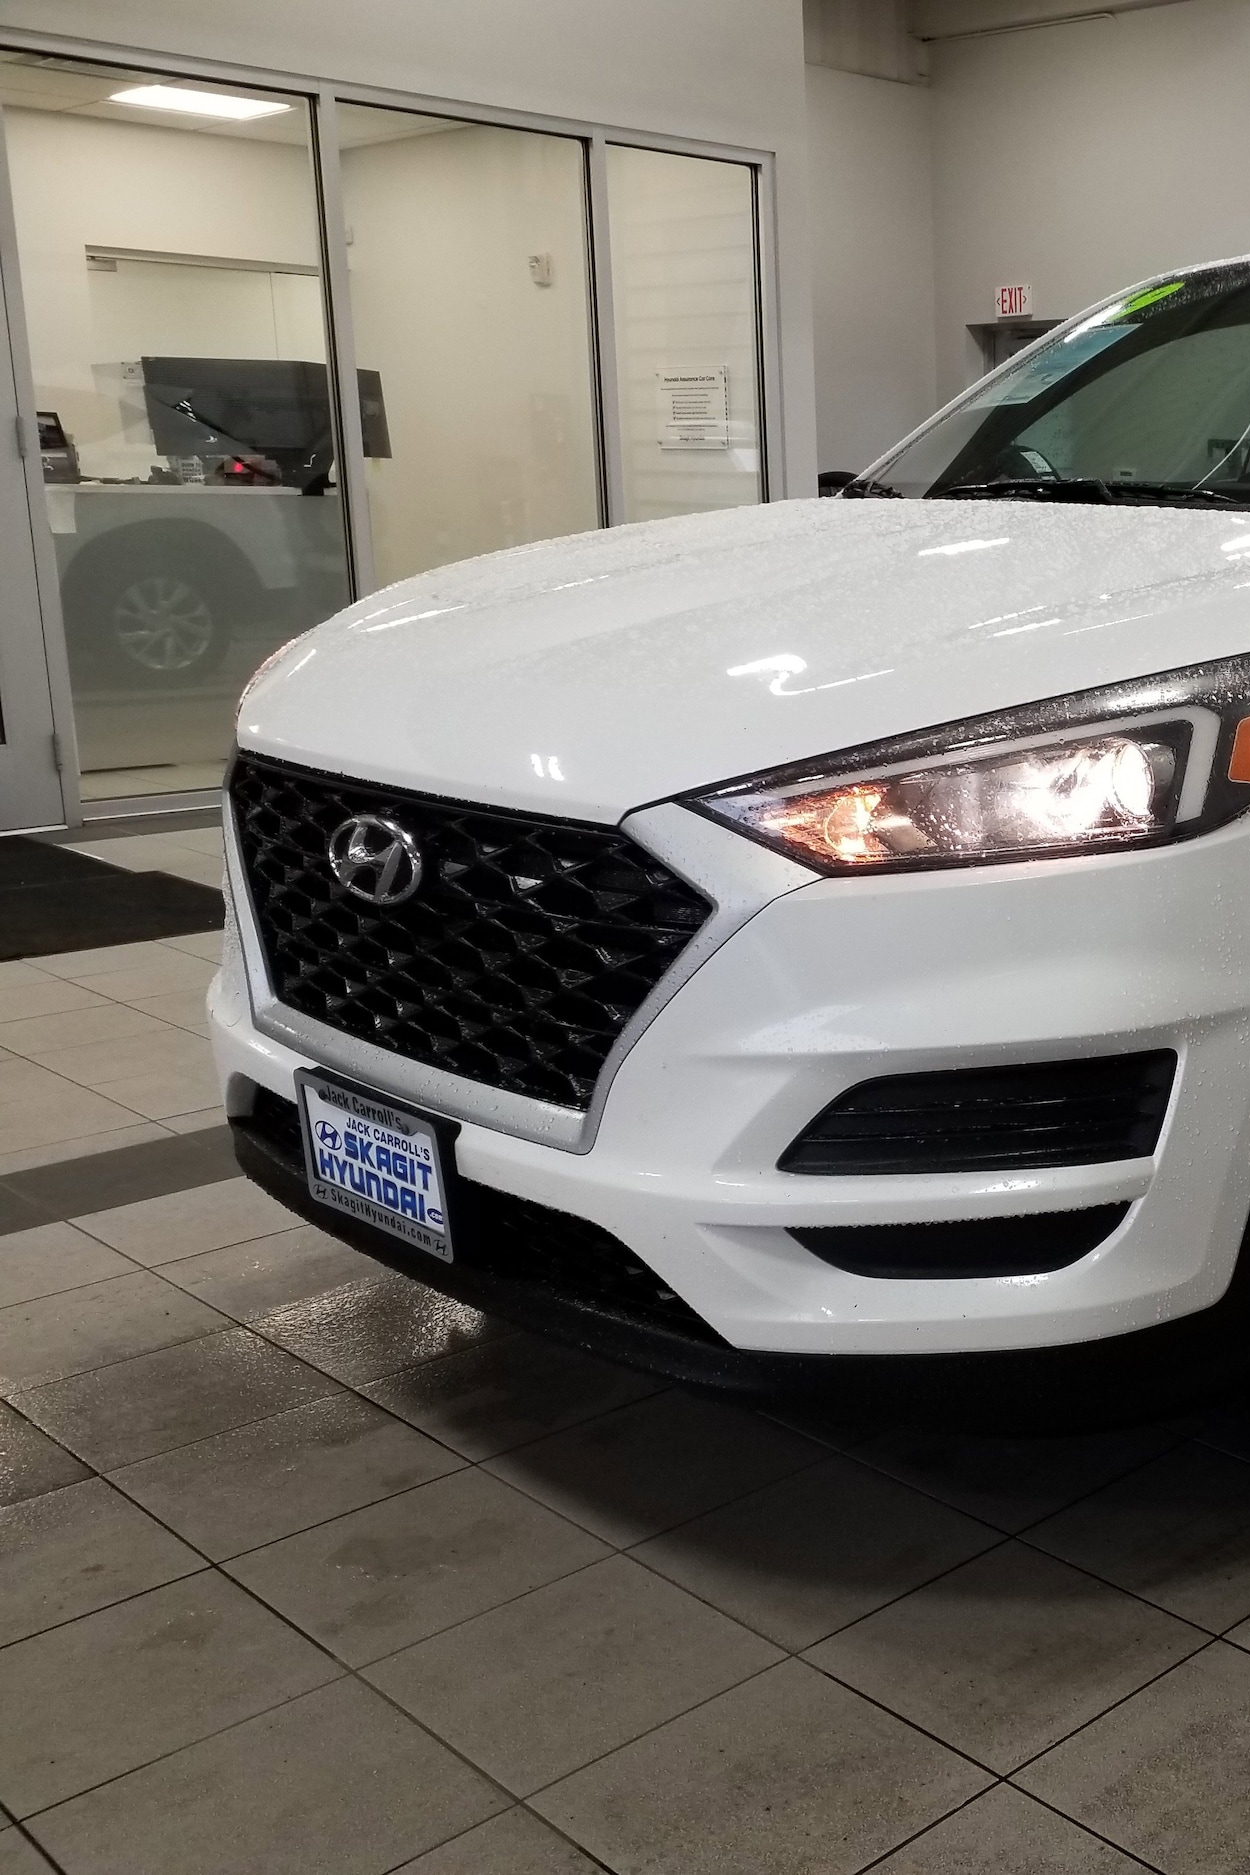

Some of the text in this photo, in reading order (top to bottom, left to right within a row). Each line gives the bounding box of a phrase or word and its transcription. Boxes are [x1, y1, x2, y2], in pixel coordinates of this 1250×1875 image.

[1001, 287, 1023, 314] EXIT
[325, 1086, 402, 1130] Jack Carroll's
[343, 1131, 432, 1191] SKAGIT
[346, 1117, 430, 1161] JACK CARROLL'S
[319, 1148, 426, 1223] HYUNDAI
[331, 1189, 431, 1247] SkagitHyundai.com
